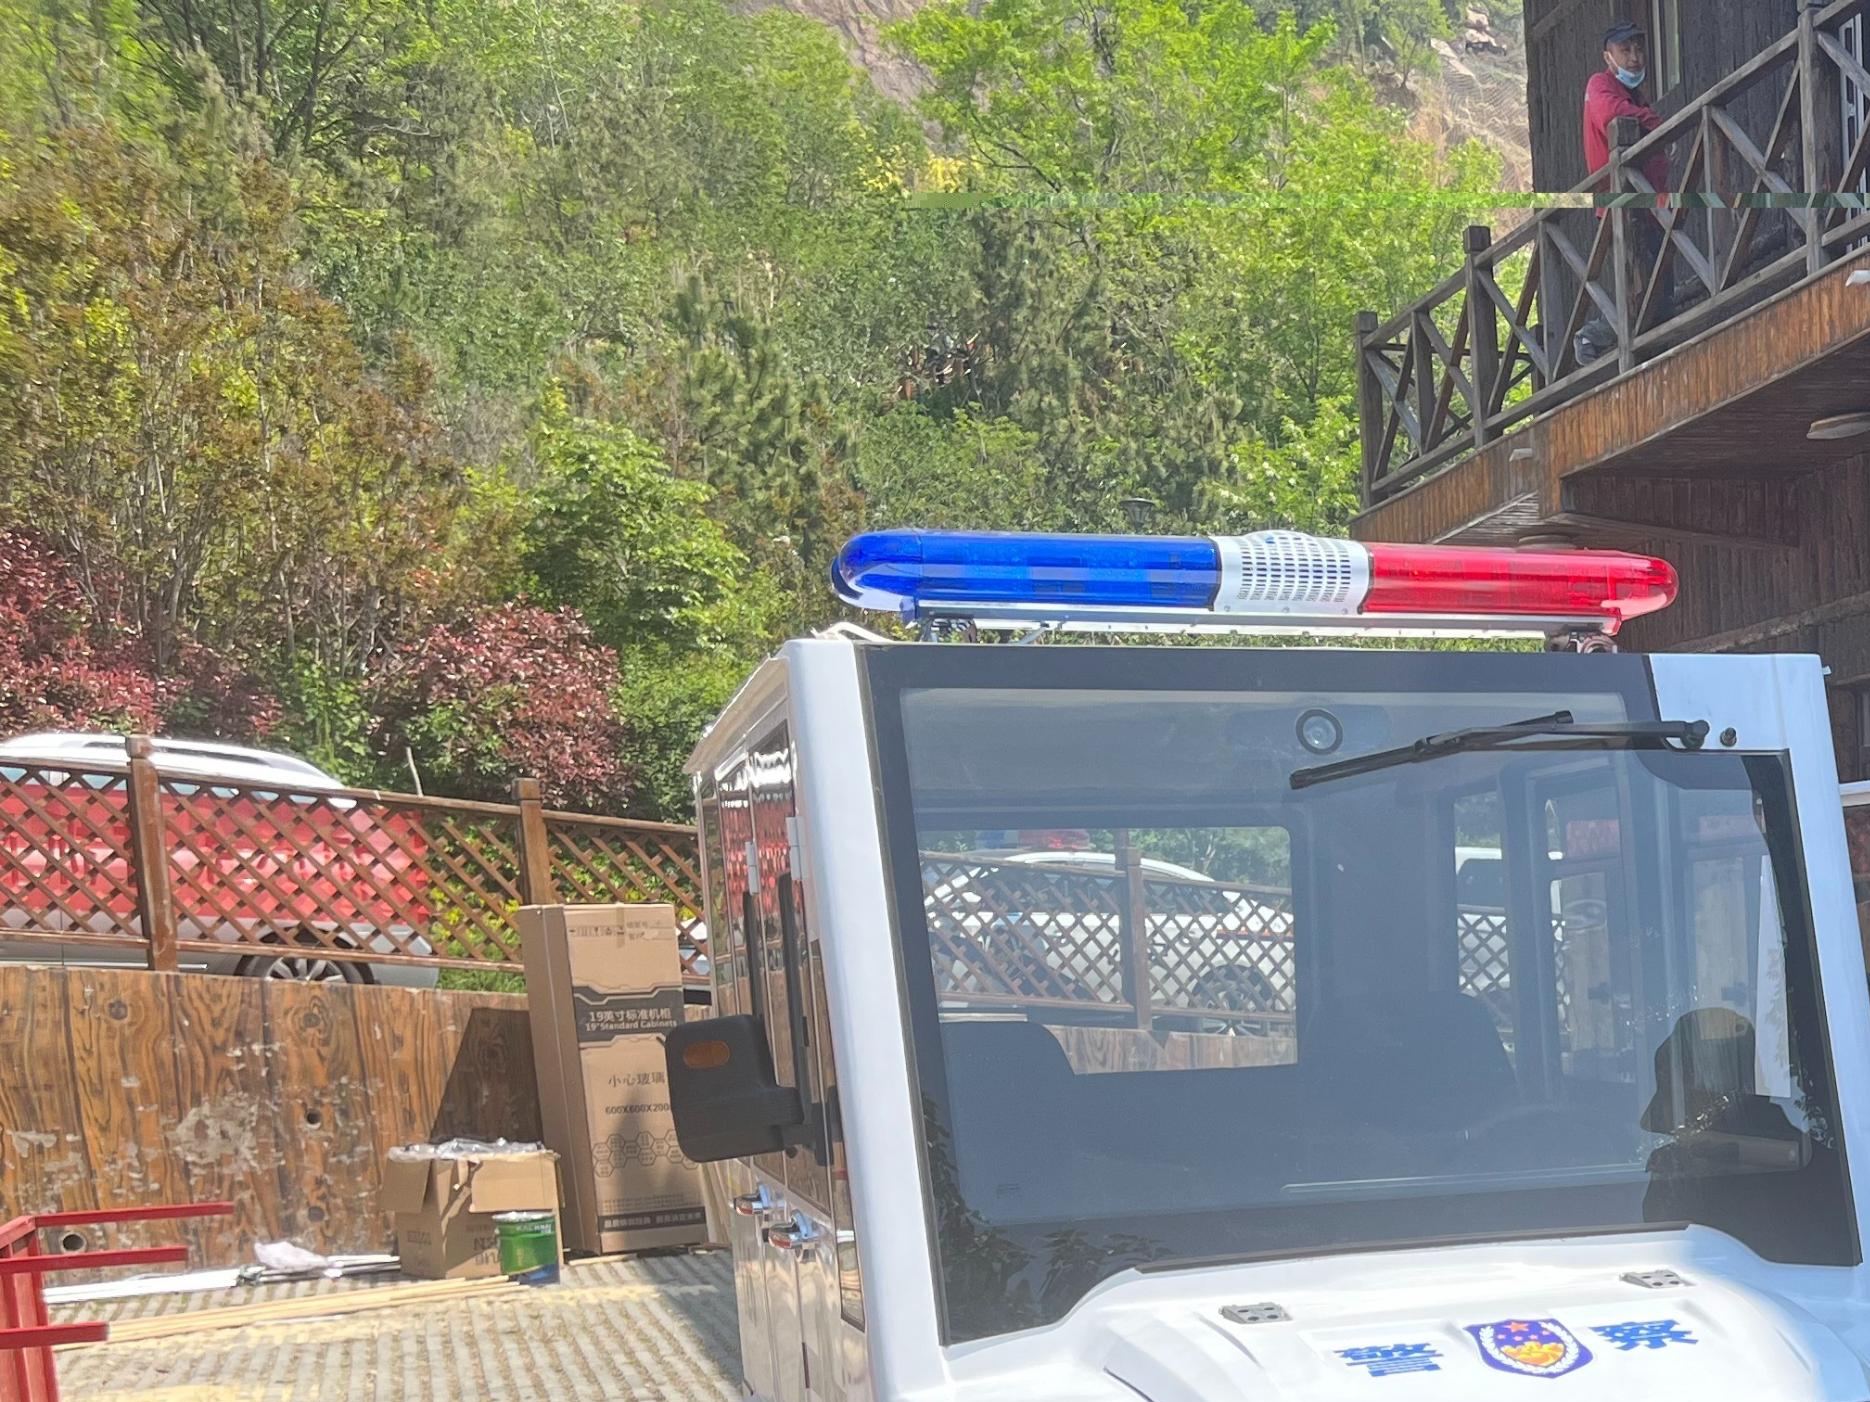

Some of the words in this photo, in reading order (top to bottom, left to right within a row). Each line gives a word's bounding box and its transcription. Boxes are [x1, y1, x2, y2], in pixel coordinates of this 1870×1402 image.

[640, 1018, 678, 1029] Cabinets
[1333, 1342, 1444, 1377] 警
[1588, 1318, 1699, 1352] 察
